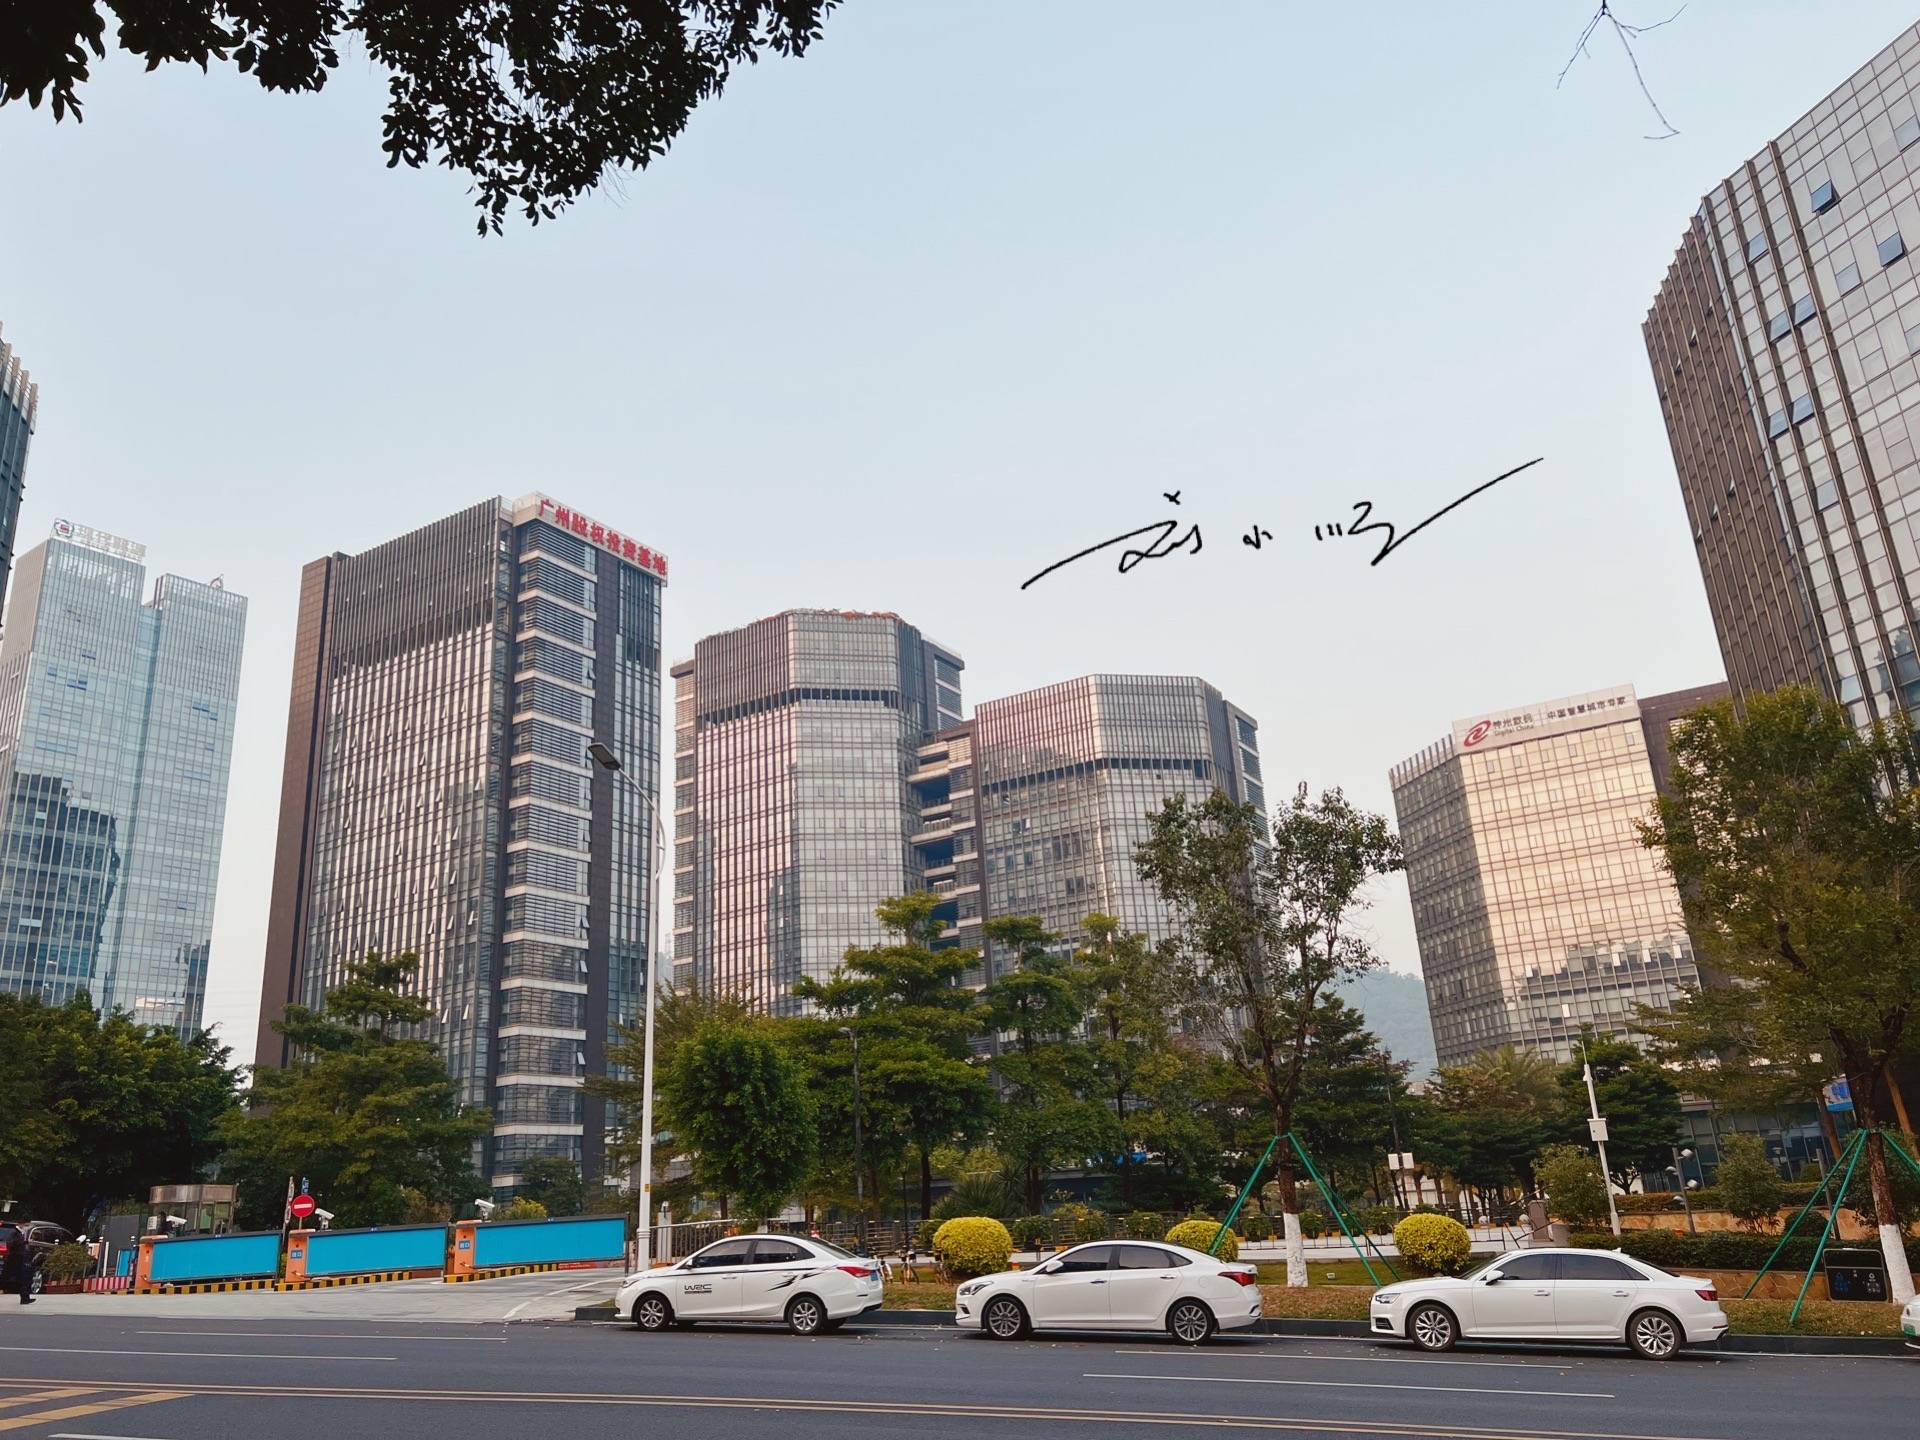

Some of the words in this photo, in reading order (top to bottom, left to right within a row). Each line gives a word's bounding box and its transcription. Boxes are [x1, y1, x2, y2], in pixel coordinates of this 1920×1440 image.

[539, 499, 667, 576] 广州股权投资基地
